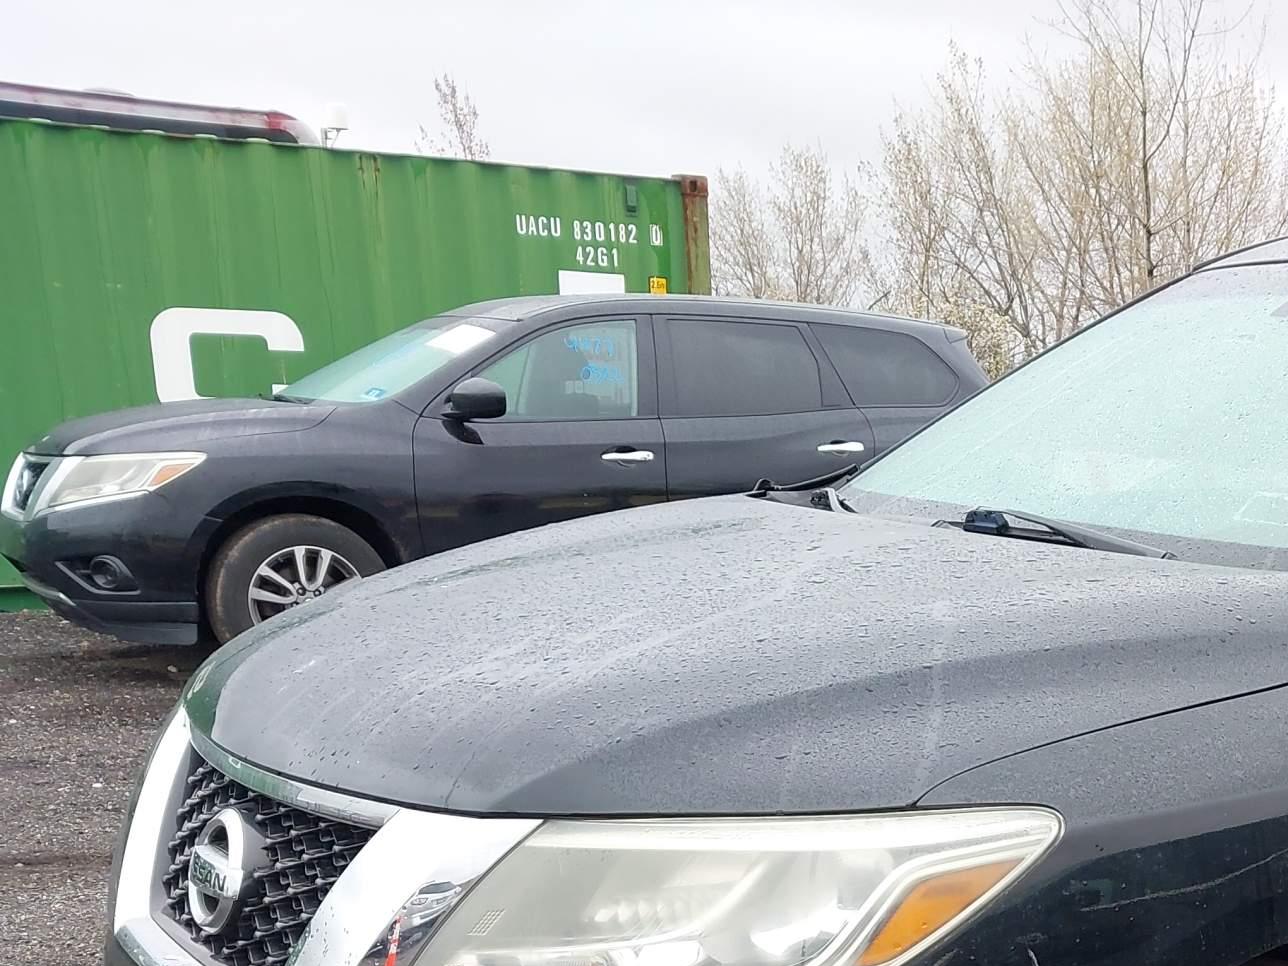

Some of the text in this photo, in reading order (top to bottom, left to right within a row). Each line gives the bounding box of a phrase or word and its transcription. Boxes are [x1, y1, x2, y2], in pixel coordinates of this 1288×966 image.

[516, 214, 663, 246] UACU 830182 0
[576, 246, 618, 267] 42G1
